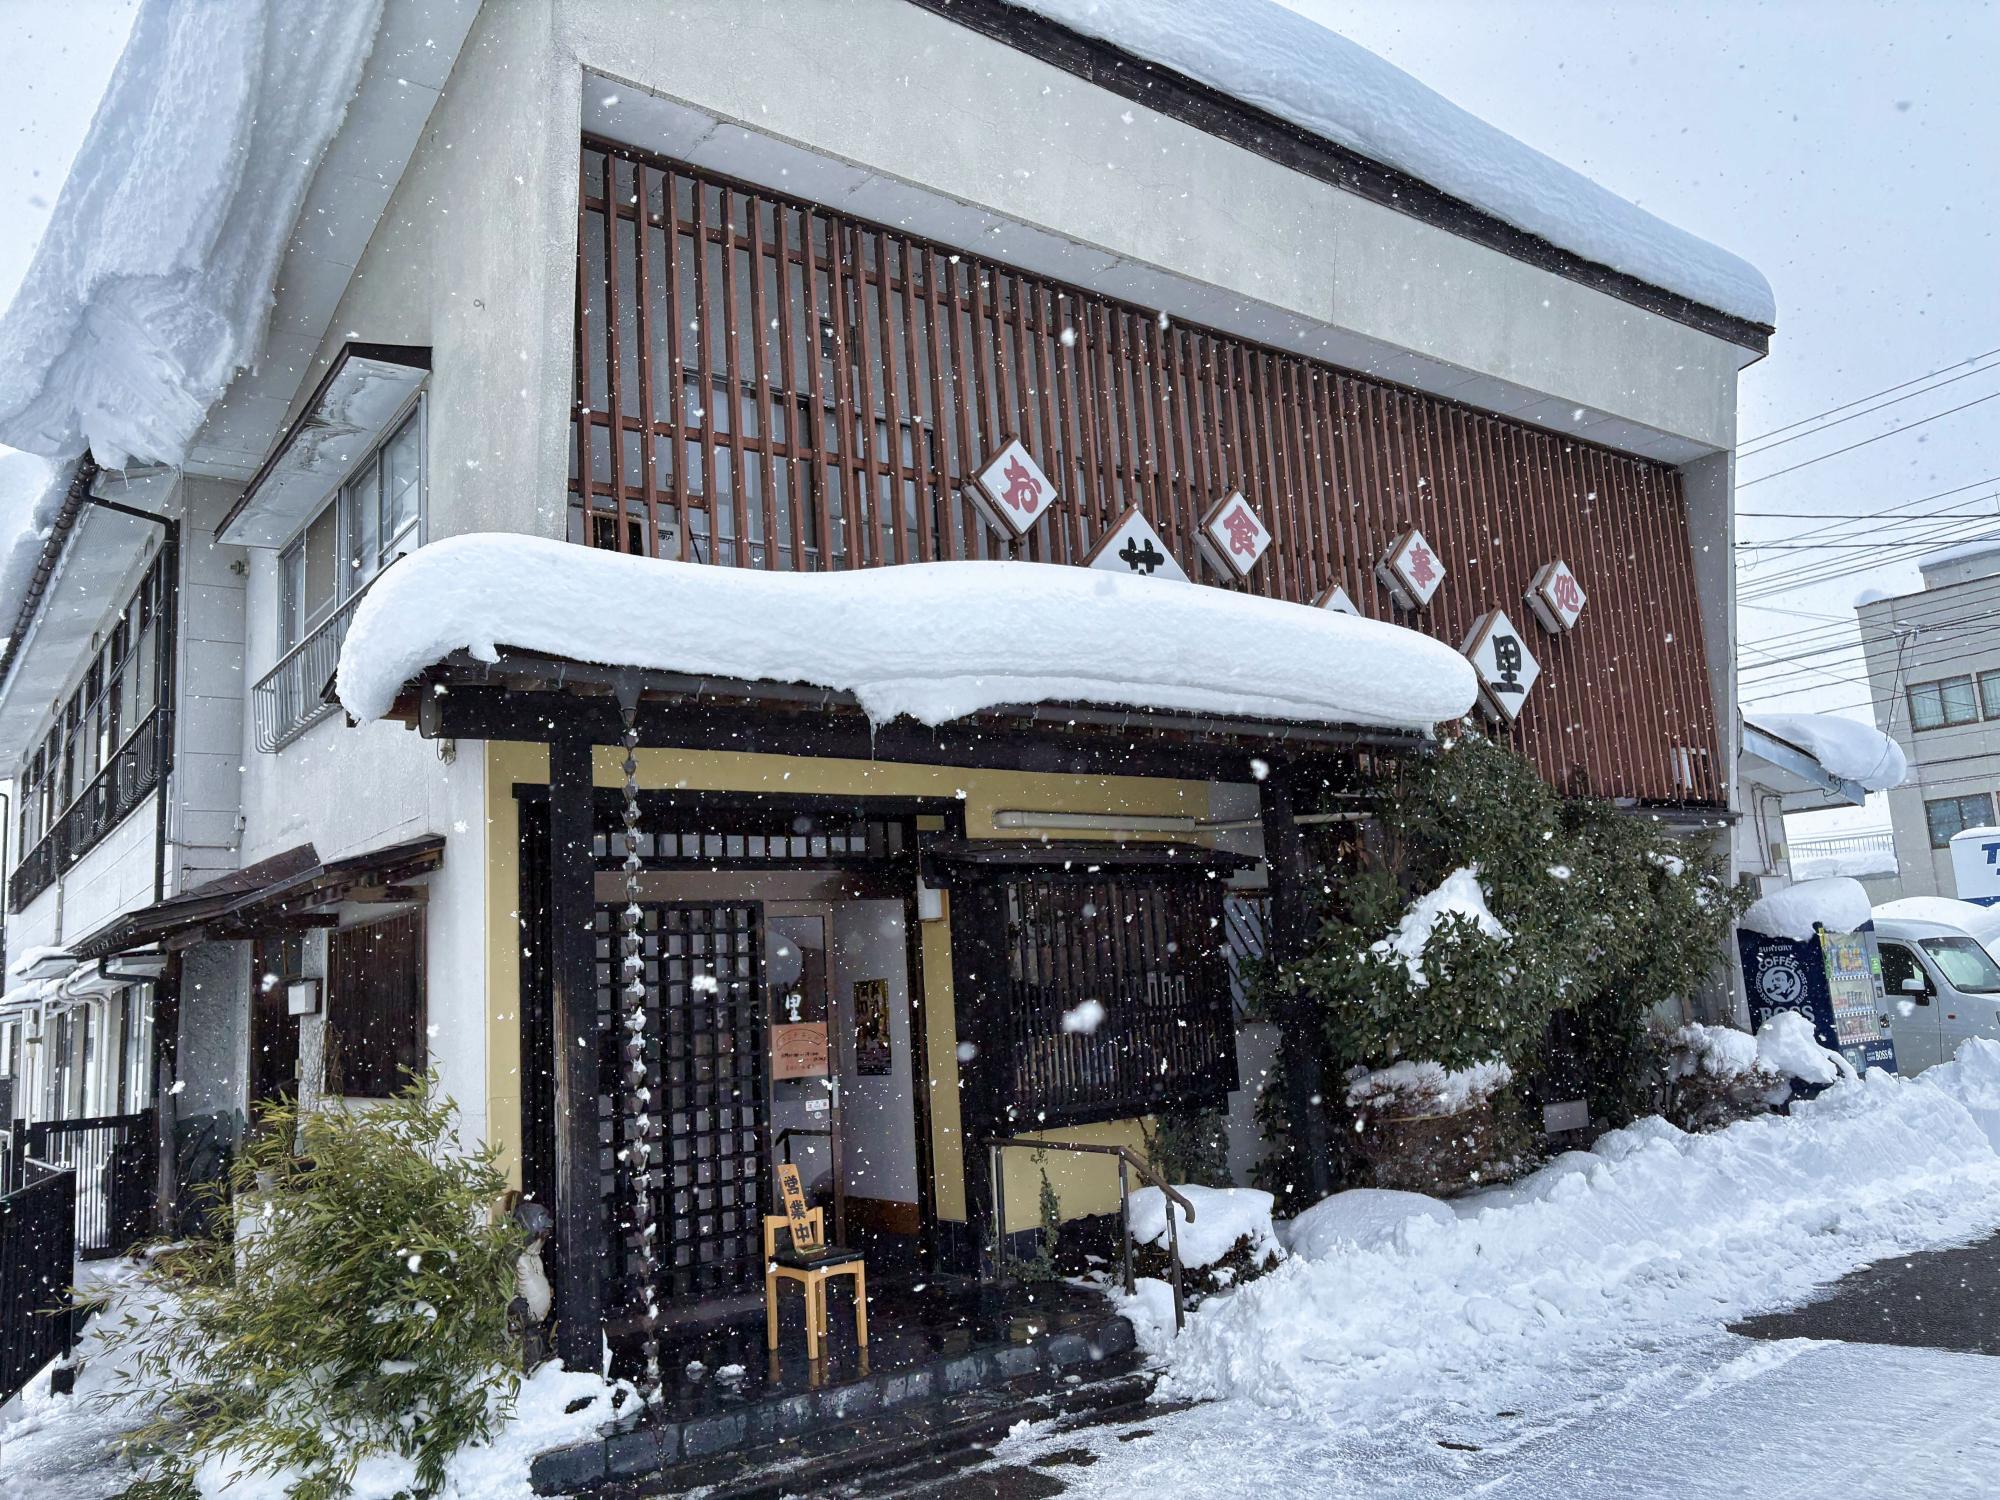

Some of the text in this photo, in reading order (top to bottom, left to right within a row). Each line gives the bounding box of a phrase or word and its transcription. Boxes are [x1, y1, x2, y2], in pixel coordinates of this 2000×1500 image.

[1001, 455, 1042, 513] お
[1223, 504, 1259, 558] 食
[1409, 542, 1436, 589] 事
[1556, 573, 1580, 612] 処
[1490, 634, 1525, 694] 里
[1758, 944, 1793, 953] SUNTORY
[1758, 955, 1800, 972] COFFEE
[785, 994, 802, 1022] 里
[783, 1174, 810, 1243] 営業中
